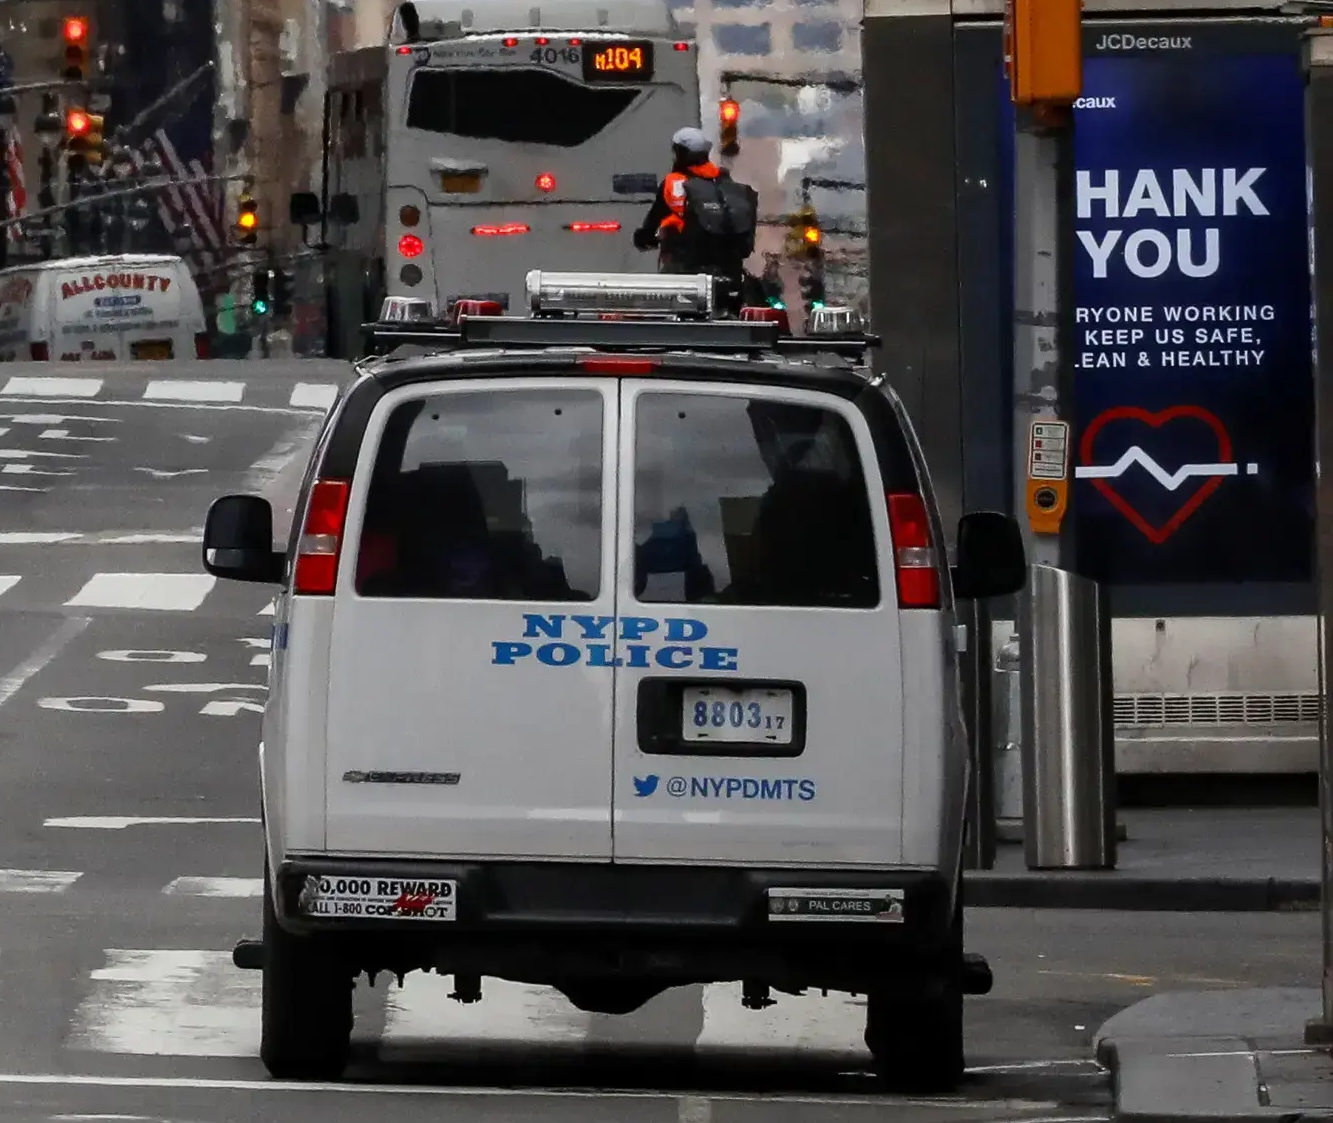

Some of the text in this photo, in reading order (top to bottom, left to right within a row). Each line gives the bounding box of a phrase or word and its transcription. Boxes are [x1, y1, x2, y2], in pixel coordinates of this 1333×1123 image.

[1095, 33, 1193, 50] JCDecaux
[530, 47, 580, 65] 4016
[1072, 95, 1116, 109] caux
[1075, 167, 1271, 218] HANK
[1075, 228, 1221, 278] YOU
[1075, 305, 1276, 323] RYONE WORKING
[1085, 327, 1262, 346] KEEP US SAFE,
[1074, 350, 1265, 368] EAN & HEALTHY
[522, 613, 709, 642] NYPD
[491, 641, 739, 671] POLICE
[694, 700, 785, 730] 8803 17
[666, 776, 816, 801] @NYPDMTS
[317, 879, 453, 898] 0,000 REWARD
[334, 902, 362, 915] 1-800
[808, 900, 872, 912] PAL CARES
